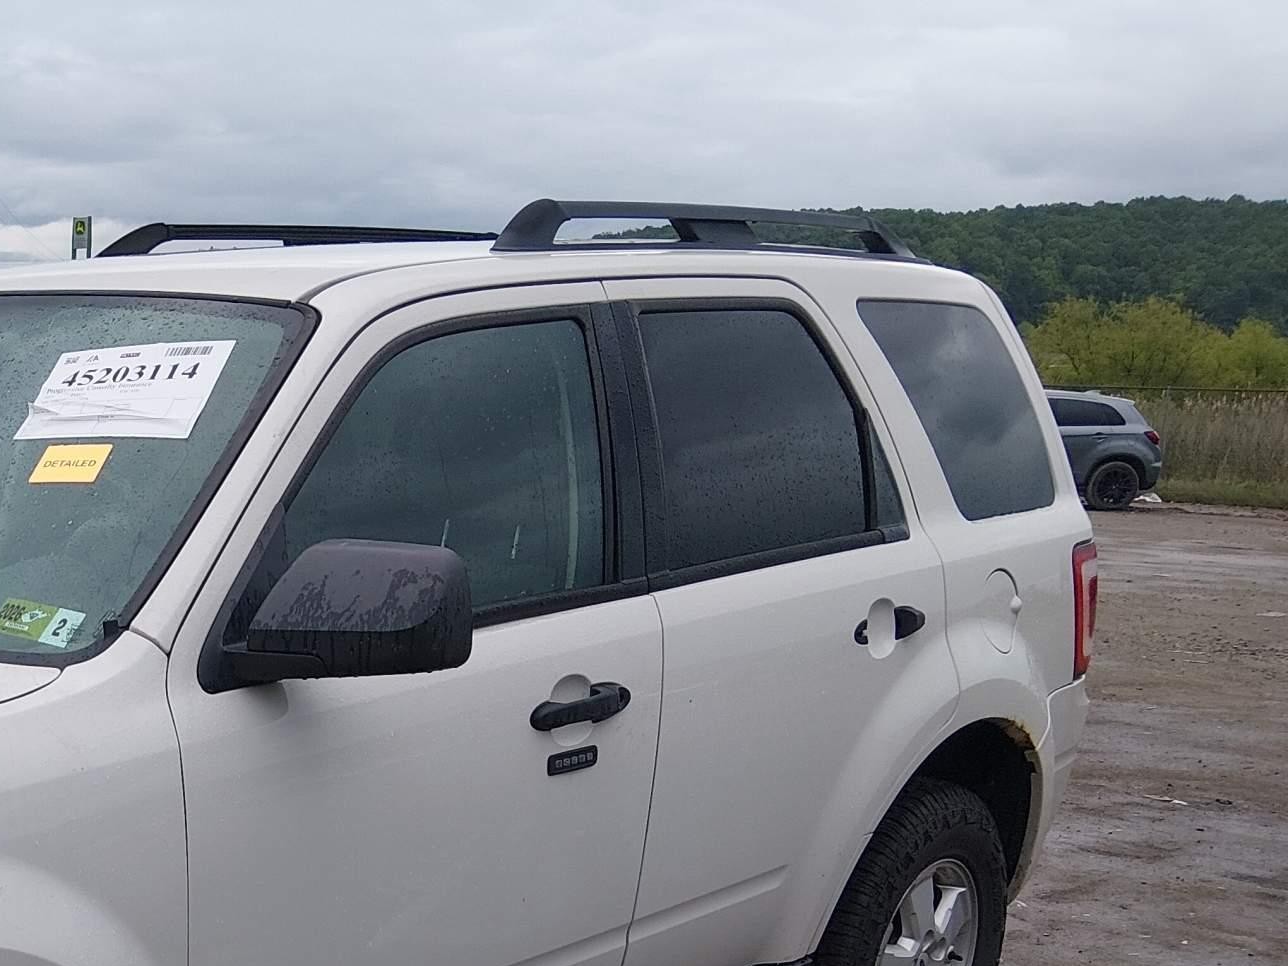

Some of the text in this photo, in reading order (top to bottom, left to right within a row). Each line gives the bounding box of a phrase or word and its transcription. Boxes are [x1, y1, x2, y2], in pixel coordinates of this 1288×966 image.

[62, 362, 201, 387] 45203114
[43, 460, 97, 468] DETAILED
[51, 618, 68, 637] 2
